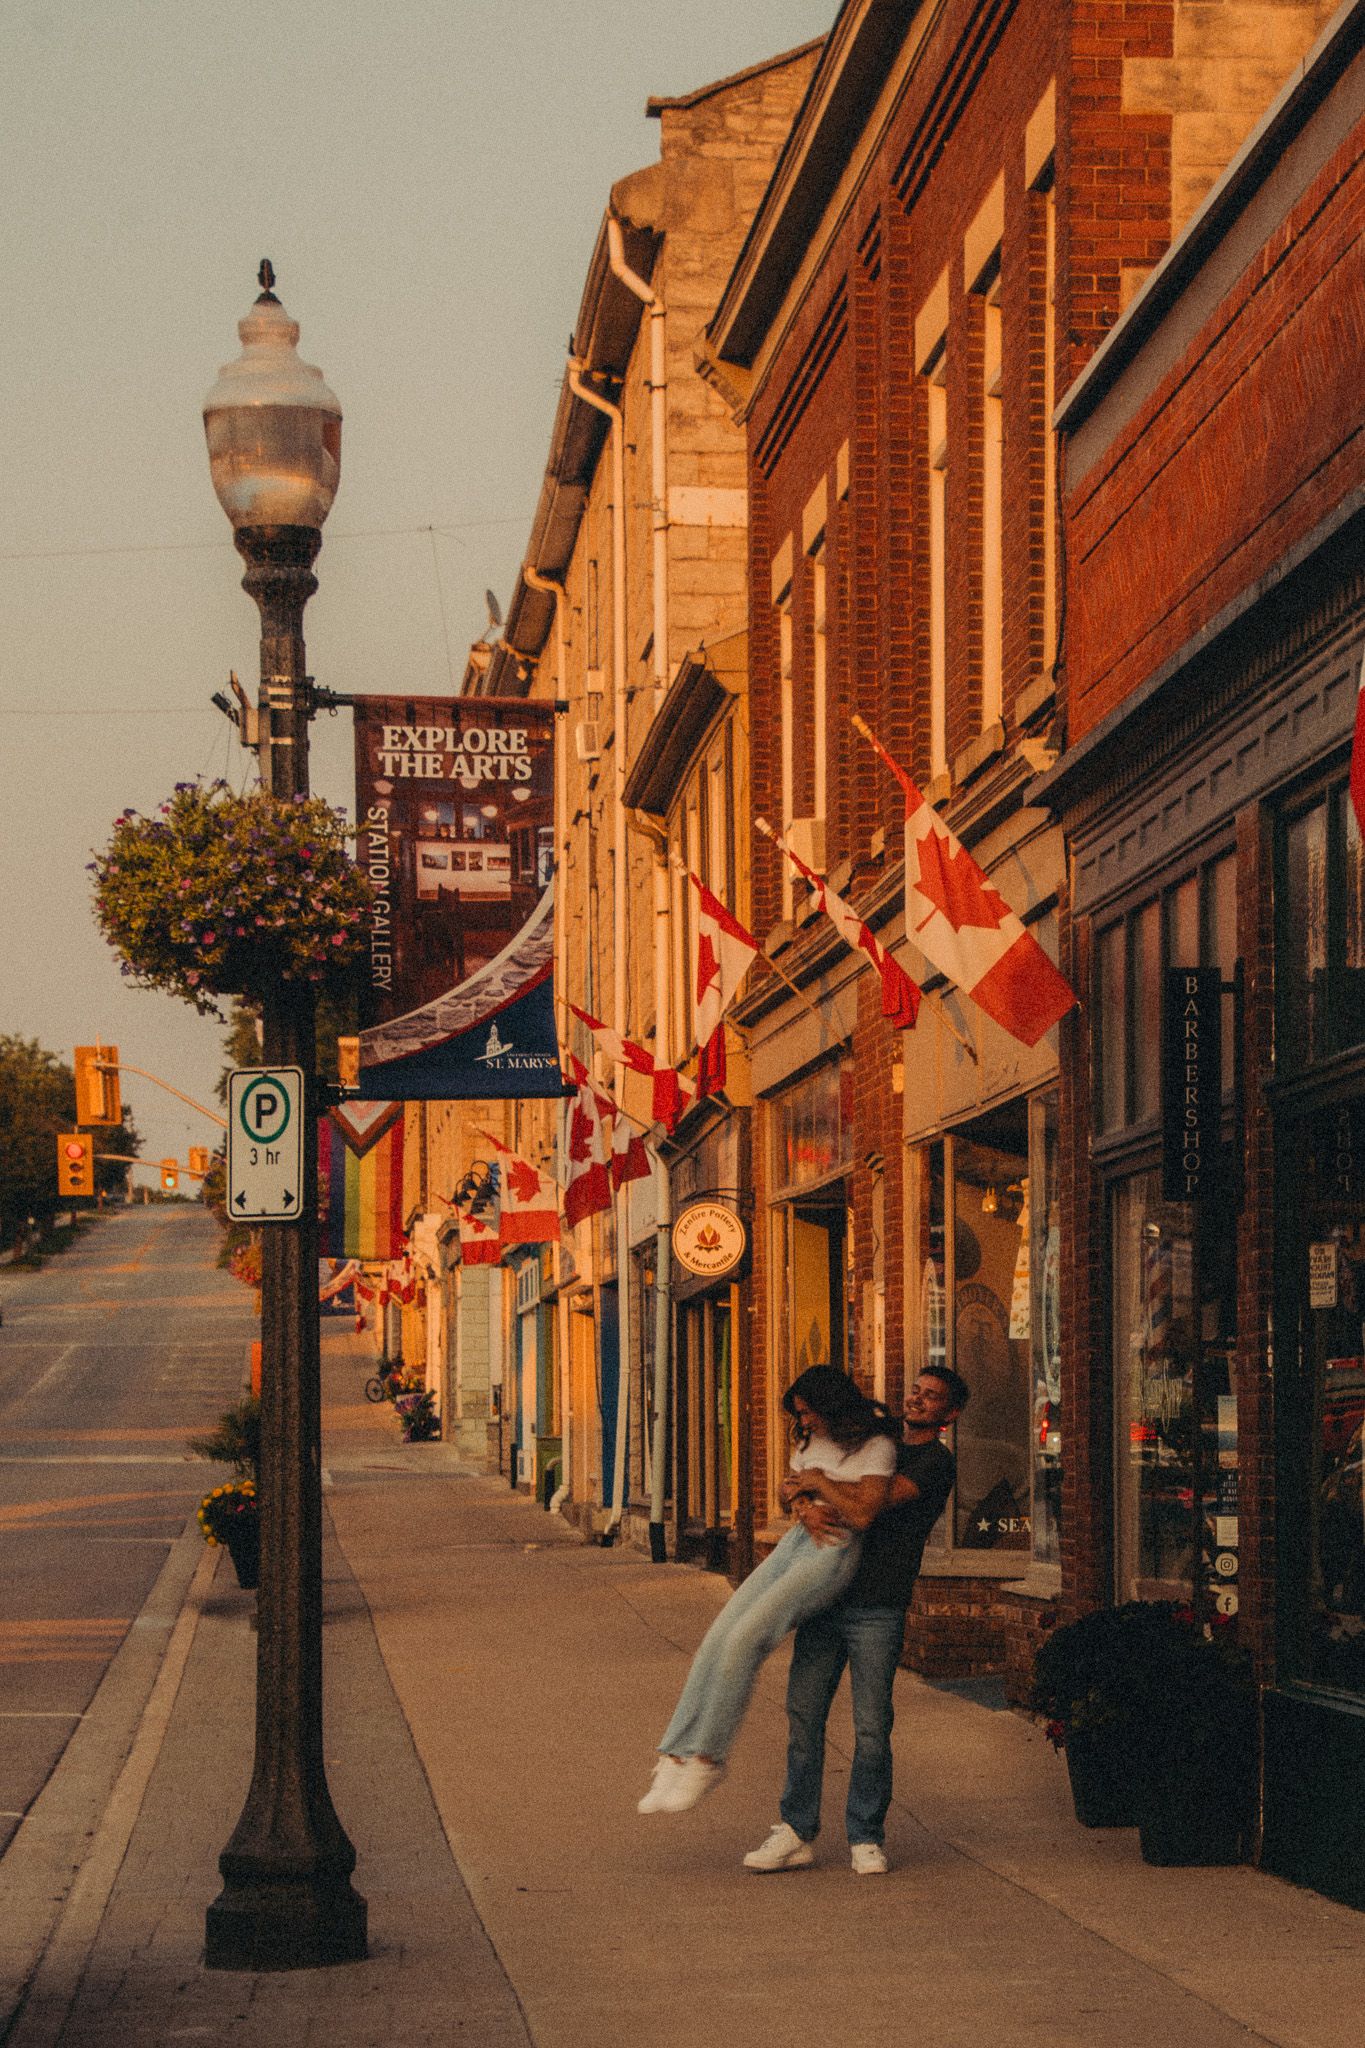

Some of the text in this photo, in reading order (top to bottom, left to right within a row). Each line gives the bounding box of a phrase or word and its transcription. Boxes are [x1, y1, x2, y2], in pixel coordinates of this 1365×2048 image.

[382, 725, 528, 754] EXPLORE
[377, 752, 533, 781] THE ARTS
[367, 806, 393, 992] STATION GALLERY
[1183, 976, 1200, 1193] BARBERSHOP
[255, 1093, 278, 1129] P
[249, 1147, 280, 1166] 3 hr
[681, 1210, 736, 1235] Zenfire Pottery
[684, 1251, 733, 1269] & Mercantile
